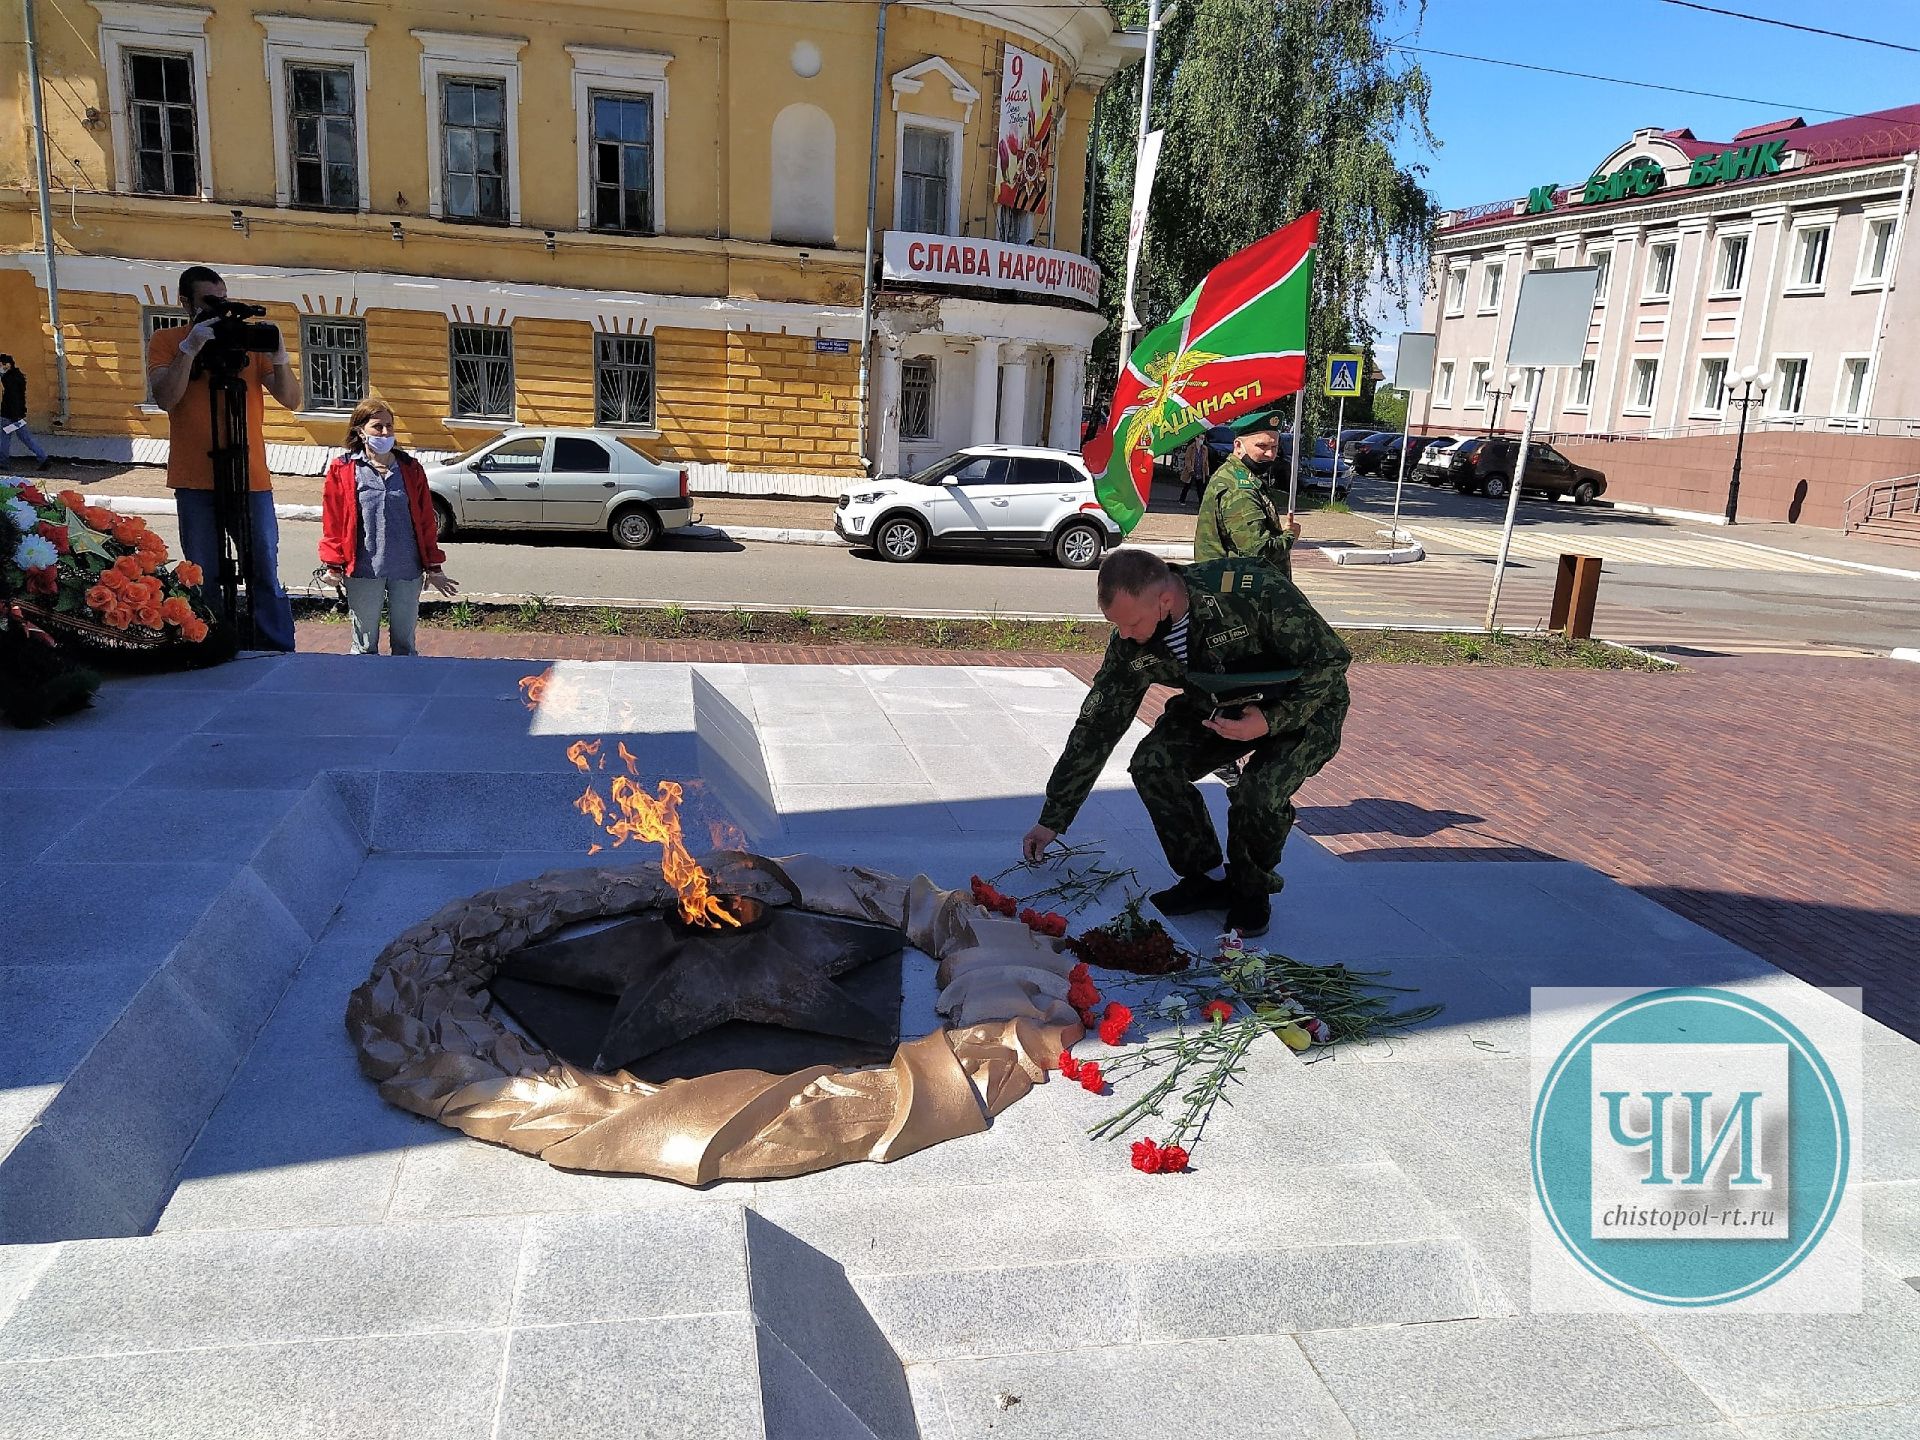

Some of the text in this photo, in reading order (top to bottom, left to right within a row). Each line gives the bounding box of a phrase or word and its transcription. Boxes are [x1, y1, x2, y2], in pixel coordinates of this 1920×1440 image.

[1011, 55, 1023, 90] 9
[1005, 90, 1028, 102] мая
[1582, 164, 1664, 205] БАРС
[1686, 139, 1789, 187] БАНК
[908, 242, 991, 278] СЛАВА
[1240, 574, 1254, 589] ПВ
